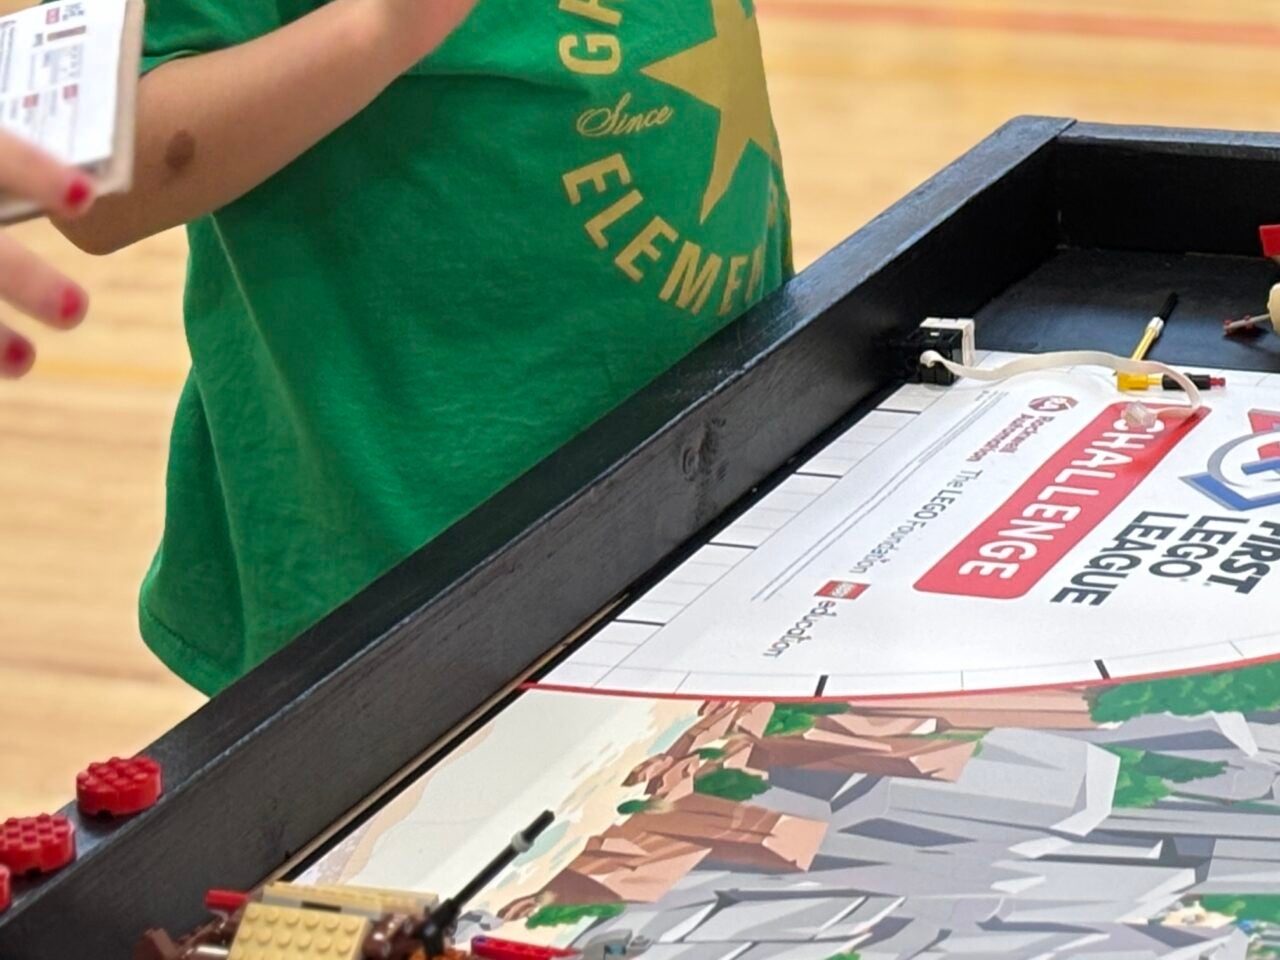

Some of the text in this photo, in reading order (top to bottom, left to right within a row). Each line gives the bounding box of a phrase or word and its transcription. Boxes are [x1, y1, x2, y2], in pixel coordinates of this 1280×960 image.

[575, 92, 674, 137] Since
[913, 488, 963, 521] LEGO
[848, 519, 927, 574] Foundation
[1049, 510, 1190, 607] LEAGUE
[1148, 514, 1251, 579] LEGO
[762, 600, 837, 658] education
